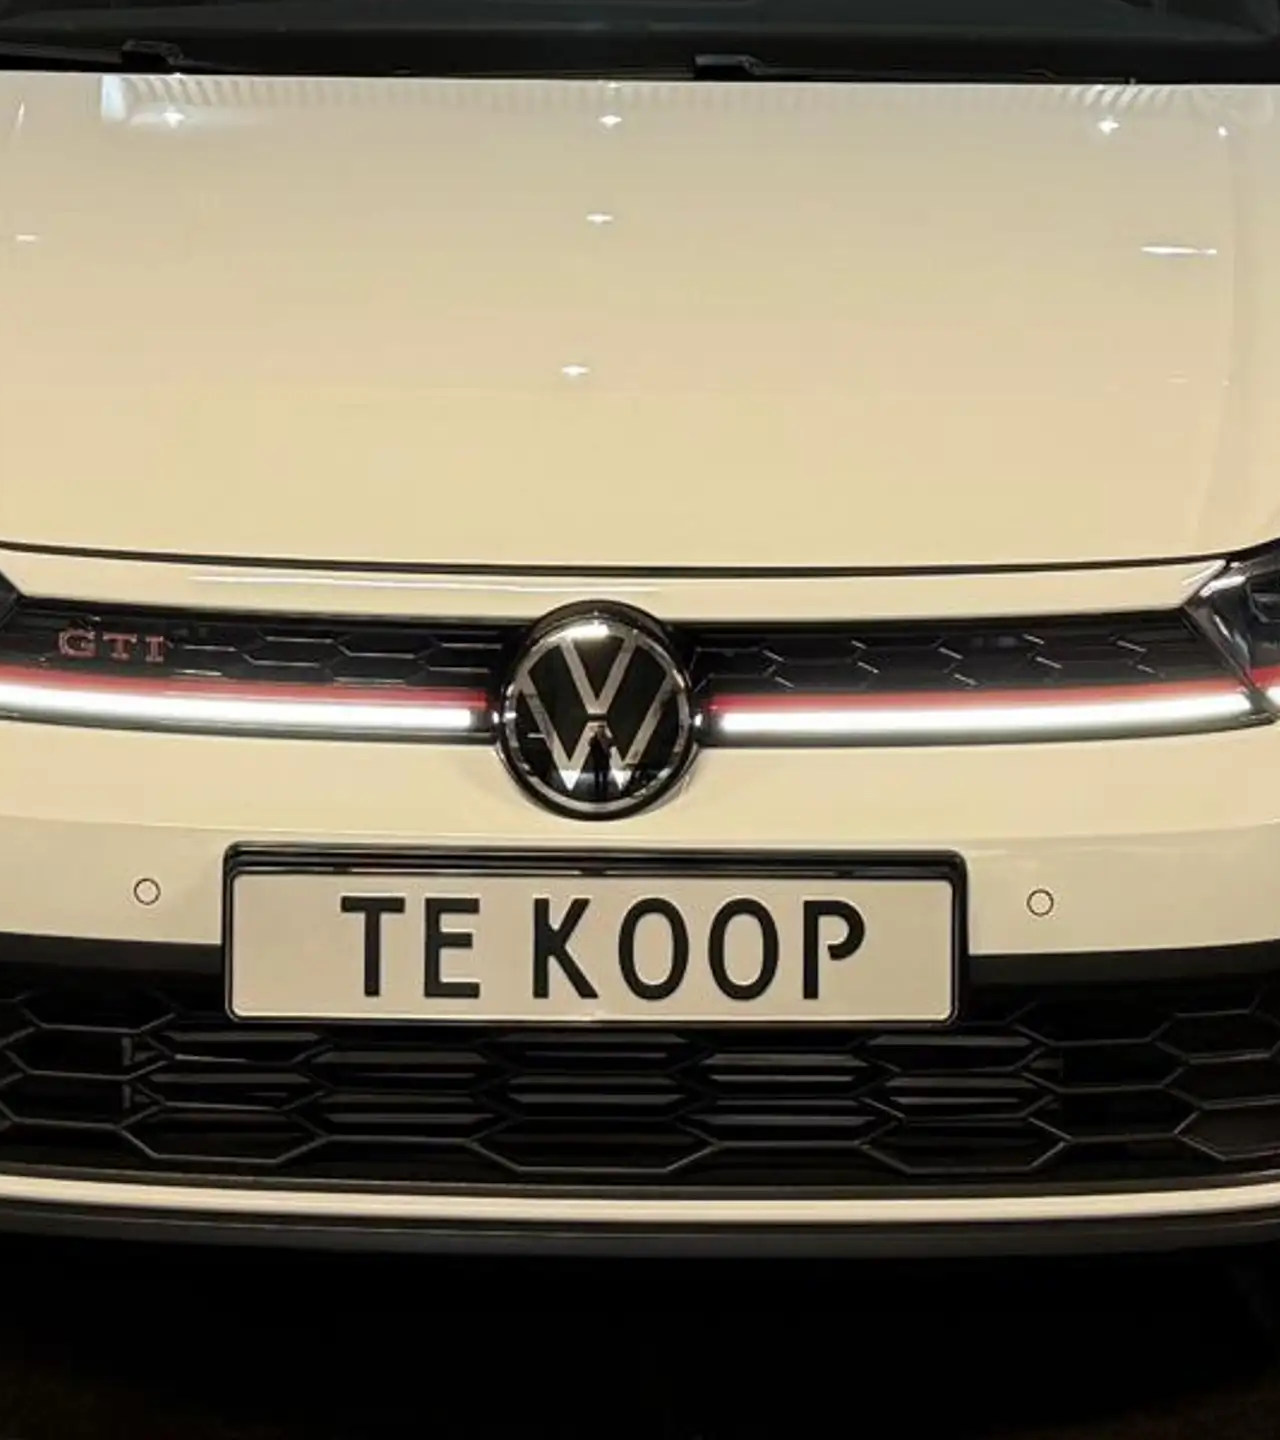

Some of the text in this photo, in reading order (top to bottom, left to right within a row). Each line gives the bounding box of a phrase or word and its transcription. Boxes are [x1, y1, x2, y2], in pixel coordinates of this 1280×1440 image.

[58, 627, 164, 663] GTI
[340, 895, 866, 1002] TE KOOP
